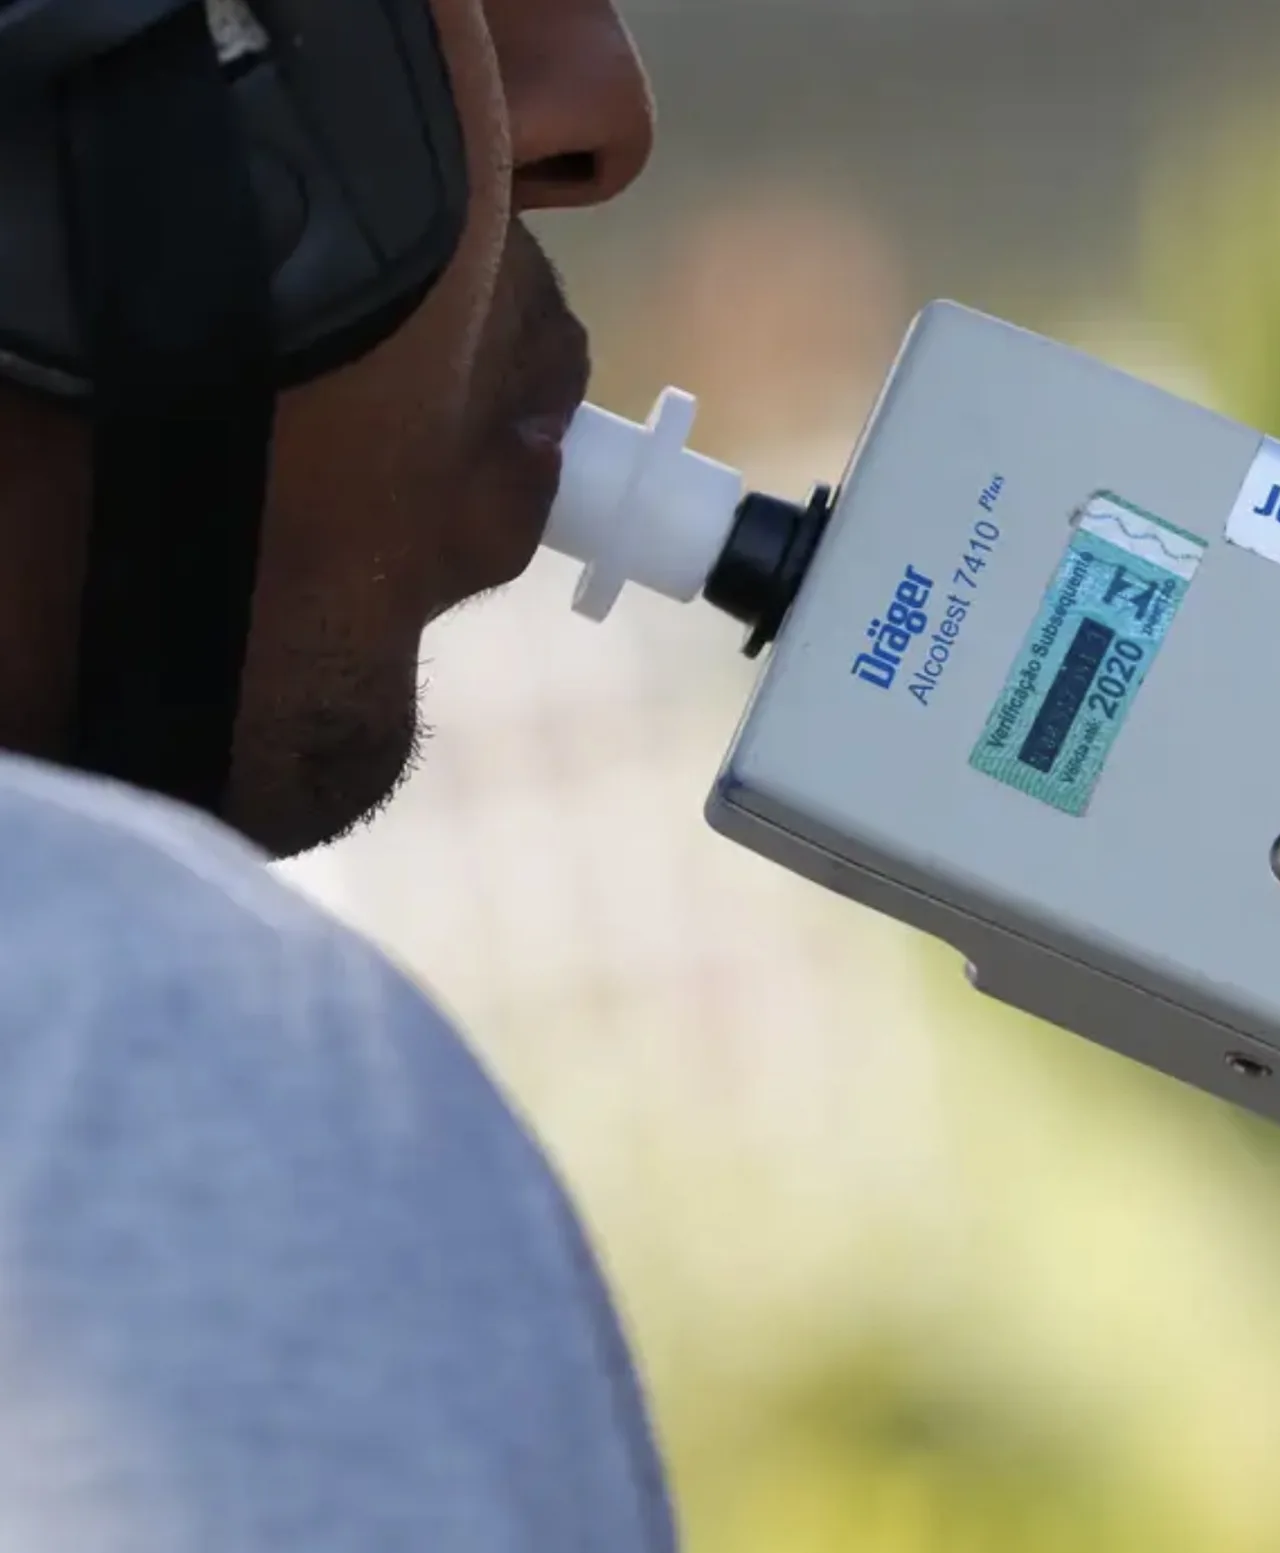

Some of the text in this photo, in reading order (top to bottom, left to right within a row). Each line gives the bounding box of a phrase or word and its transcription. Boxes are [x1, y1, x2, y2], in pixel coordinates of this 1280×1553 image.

[851, 564, 934, 689] Dräger
[908, 474, 1005, 706] Alcotest 7410 Plus
[986, 660, 1043, 750] Verificação
[1032, 551, 1094, 657] Subsequente
[1088, 639, 1144, 720] 2020
